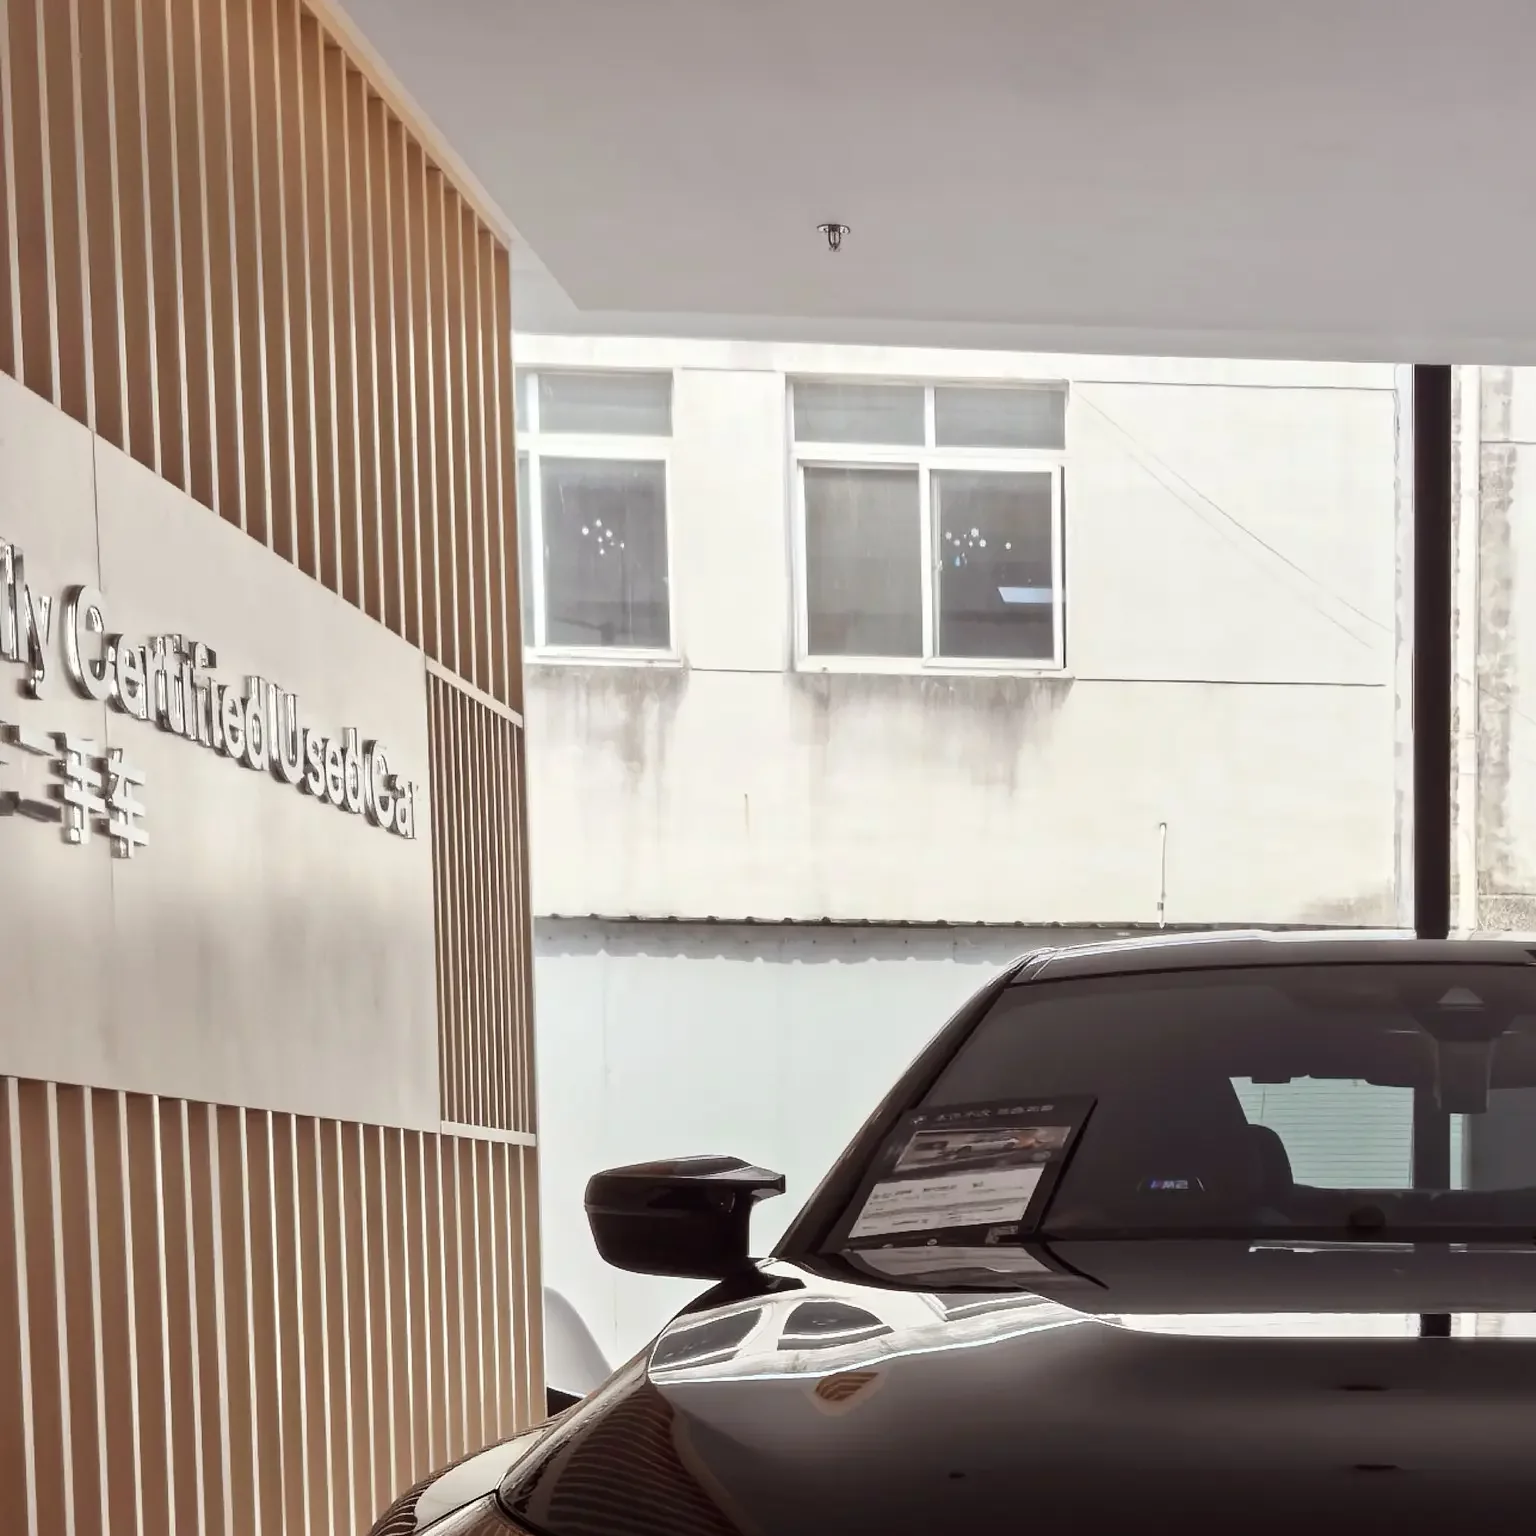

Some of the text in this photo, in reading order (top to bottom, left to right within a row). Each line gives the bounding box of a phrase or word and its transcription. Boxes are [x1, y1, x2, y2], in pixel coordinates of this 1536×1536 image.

[0, 718, 148, 859] 二手车
[62, 584, 269, 771] Certified
[268, 682, 365, 815] Used
